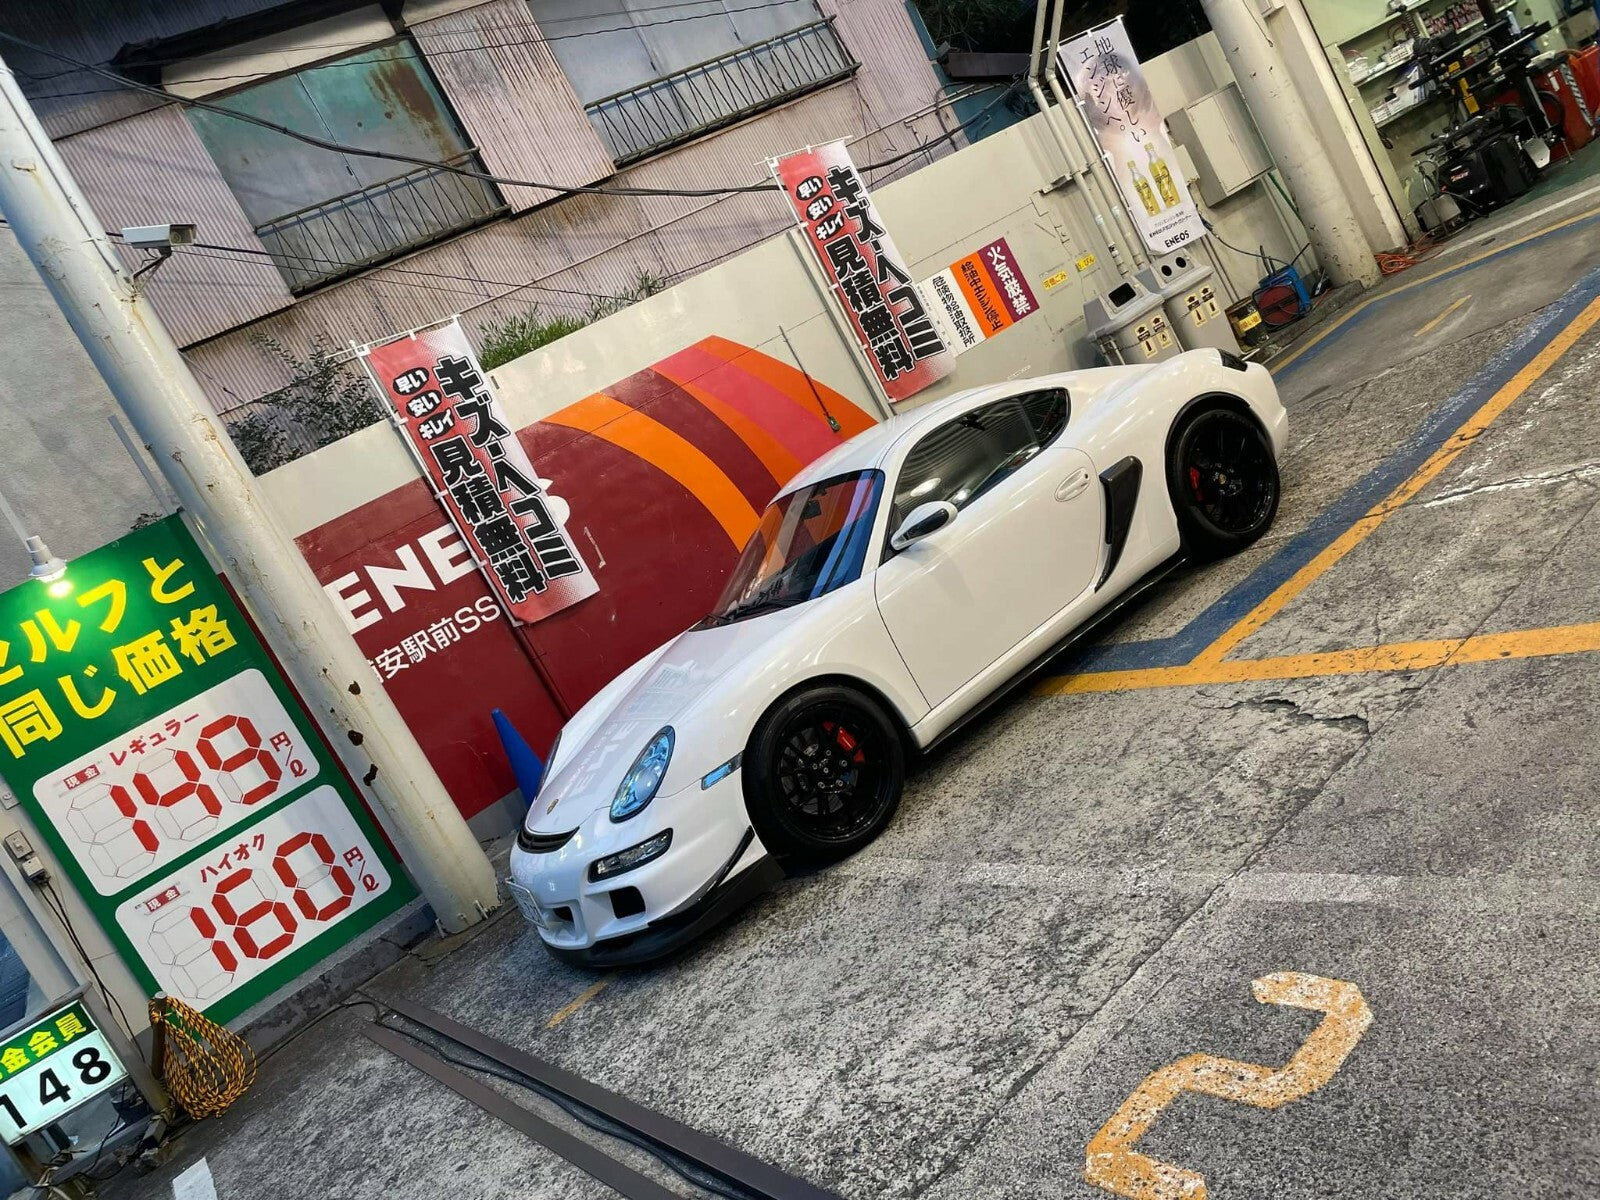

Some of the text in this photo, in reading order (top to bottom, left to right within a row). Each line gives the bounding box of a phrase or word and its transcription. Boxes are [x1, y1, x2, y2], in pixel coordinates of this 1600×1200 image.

[1079, 47, 1126, 132] エンジンへ。
[1094, 36, 1147, 143] 地球に優しい
[798, 177, 823, 198] 早い
[808, 197, 833, 220] 安い
[815, 211, 844, 240] キレイ
[827, 166, 946, 361] キズ・ヘコミ
[1164, 230, 1190, 248] ENEOS
[825, 234, 914, 380] 見積無料
[933, 276, 976, 348] 危険物給油取扱所
[960, 260, 1003, 332] 給油中エンジン停止
[986, 245, 1032, 316] 火気厳禁
[395, 368, 427, 394] 早い
[408, 391, 440, 417] 安い
[419, 409, 454, 440] キレイ
[433, 355, 583, 581] キズ・ヘコミ
[430, 435, 547, 604] 見積無料
[0, 604, 238, 760] 同じ価格
[65, 713, 200, 789] 現金 レギュラー
[109, 714, 283, 853] 149
[148, 833, 267, 911] 現金 ハイオク
[190, 831, 356, 973] 160
[0, 1012, 87, 1080] 金会員
[0, 1047, 112, 1129] 148
[1085, 971, 1374, 1200] 2
